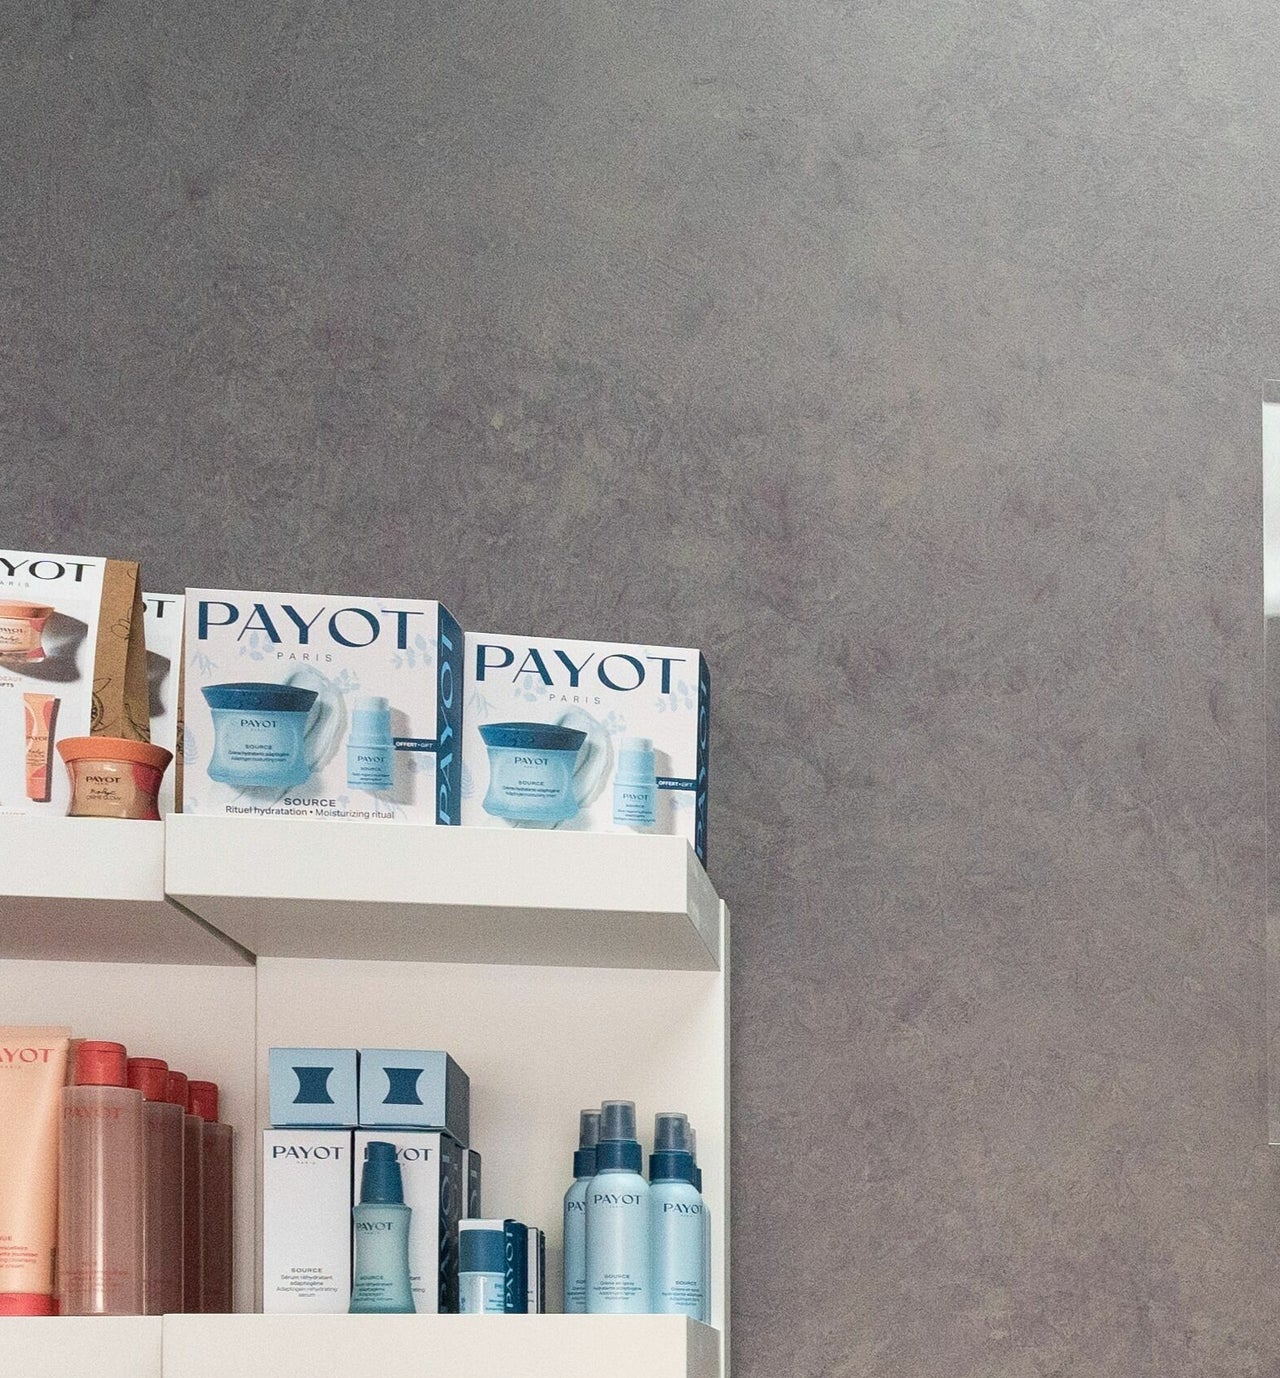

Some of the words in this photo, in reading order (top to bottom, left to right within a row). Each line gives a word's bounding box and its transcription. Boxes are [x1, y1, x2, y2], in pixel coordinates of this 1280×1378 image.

[198, 600, 425, 650] PAYOT
[277, 651, 333, 662] PARIS
[476, 644, 687, 695] PAYOT
[549, 694, 601, 705] PARIS
[240, 719, 277, 728] PAYOT
[357, 755, 385, 763] PAYOT
[514, 757, 549, 766] PAYOT
[86, 775, 122, 784] PAYOT
[284, 797, 337, 807] SOURCE
[623, 793, 649, 801] PAYOT
[225, 805, 252, 814] Rituel
[254, 807, 308, 817] hydratation
[315, 808, 369, 819] Moisturizing
[371, 810, 395, 819] ritual
[272, 1146, 344, 1160] PAYOT
[594, 1194, 642, 1205] PAYOT
[357, 1222, 394, 1231] PAYOT
